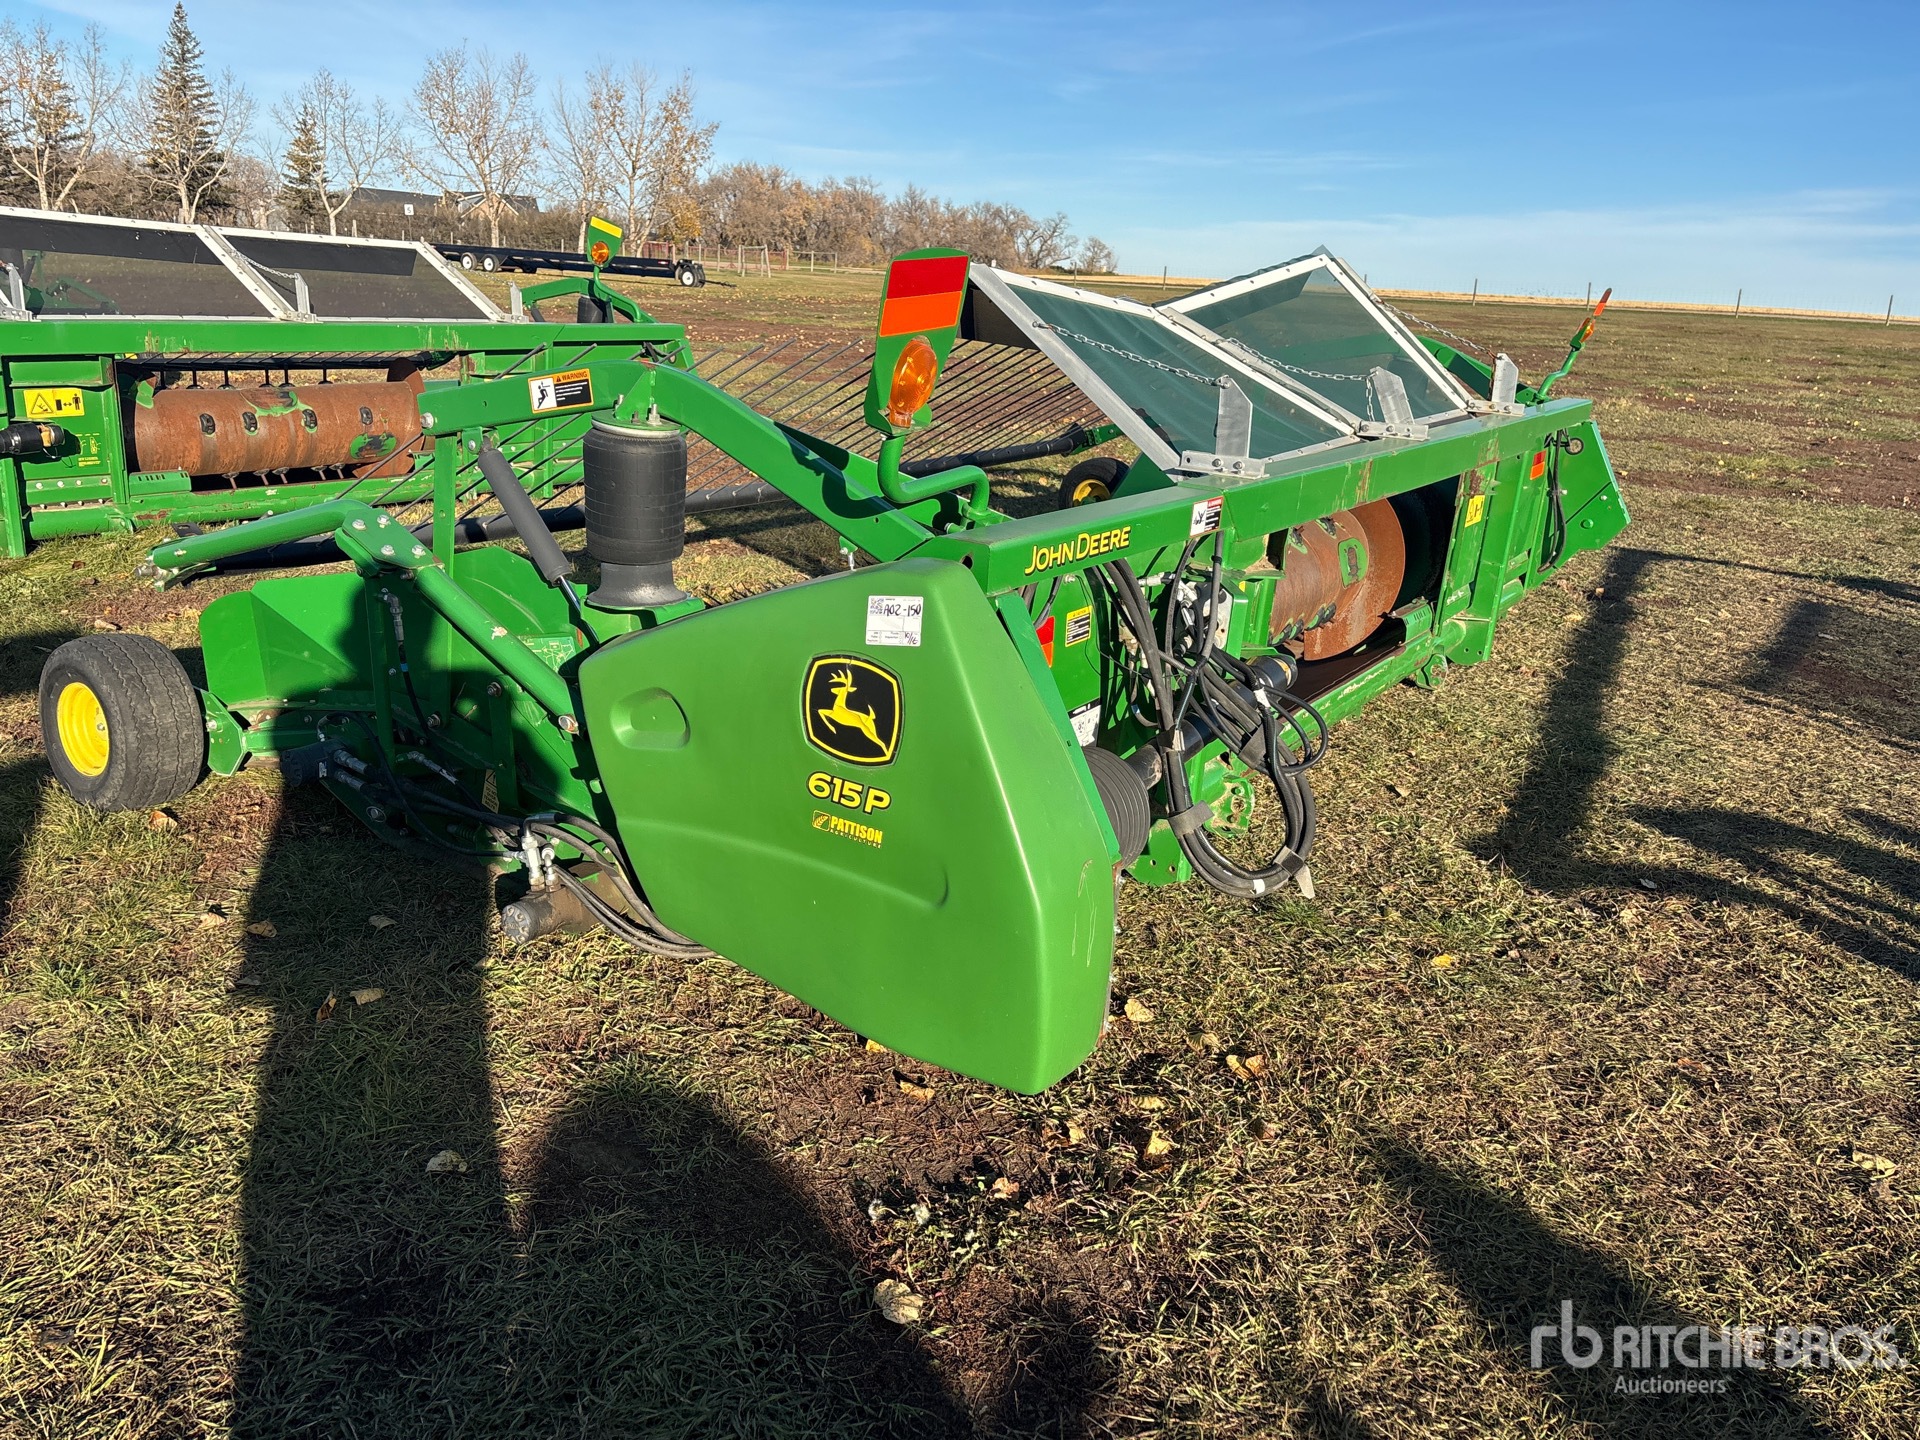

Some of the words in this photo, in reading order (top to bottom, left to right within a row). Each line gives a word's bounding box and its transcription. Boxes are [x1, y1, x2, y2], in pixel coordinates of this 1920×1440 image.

[562, 371, 588, 381] WARNING
[1024, 540, 1075, 576] JOHN
[1075, 526, 1132, 560] DEERE
[807, 771, 892, 815] 615P
[831, 816, 883, 844] PATTISON
